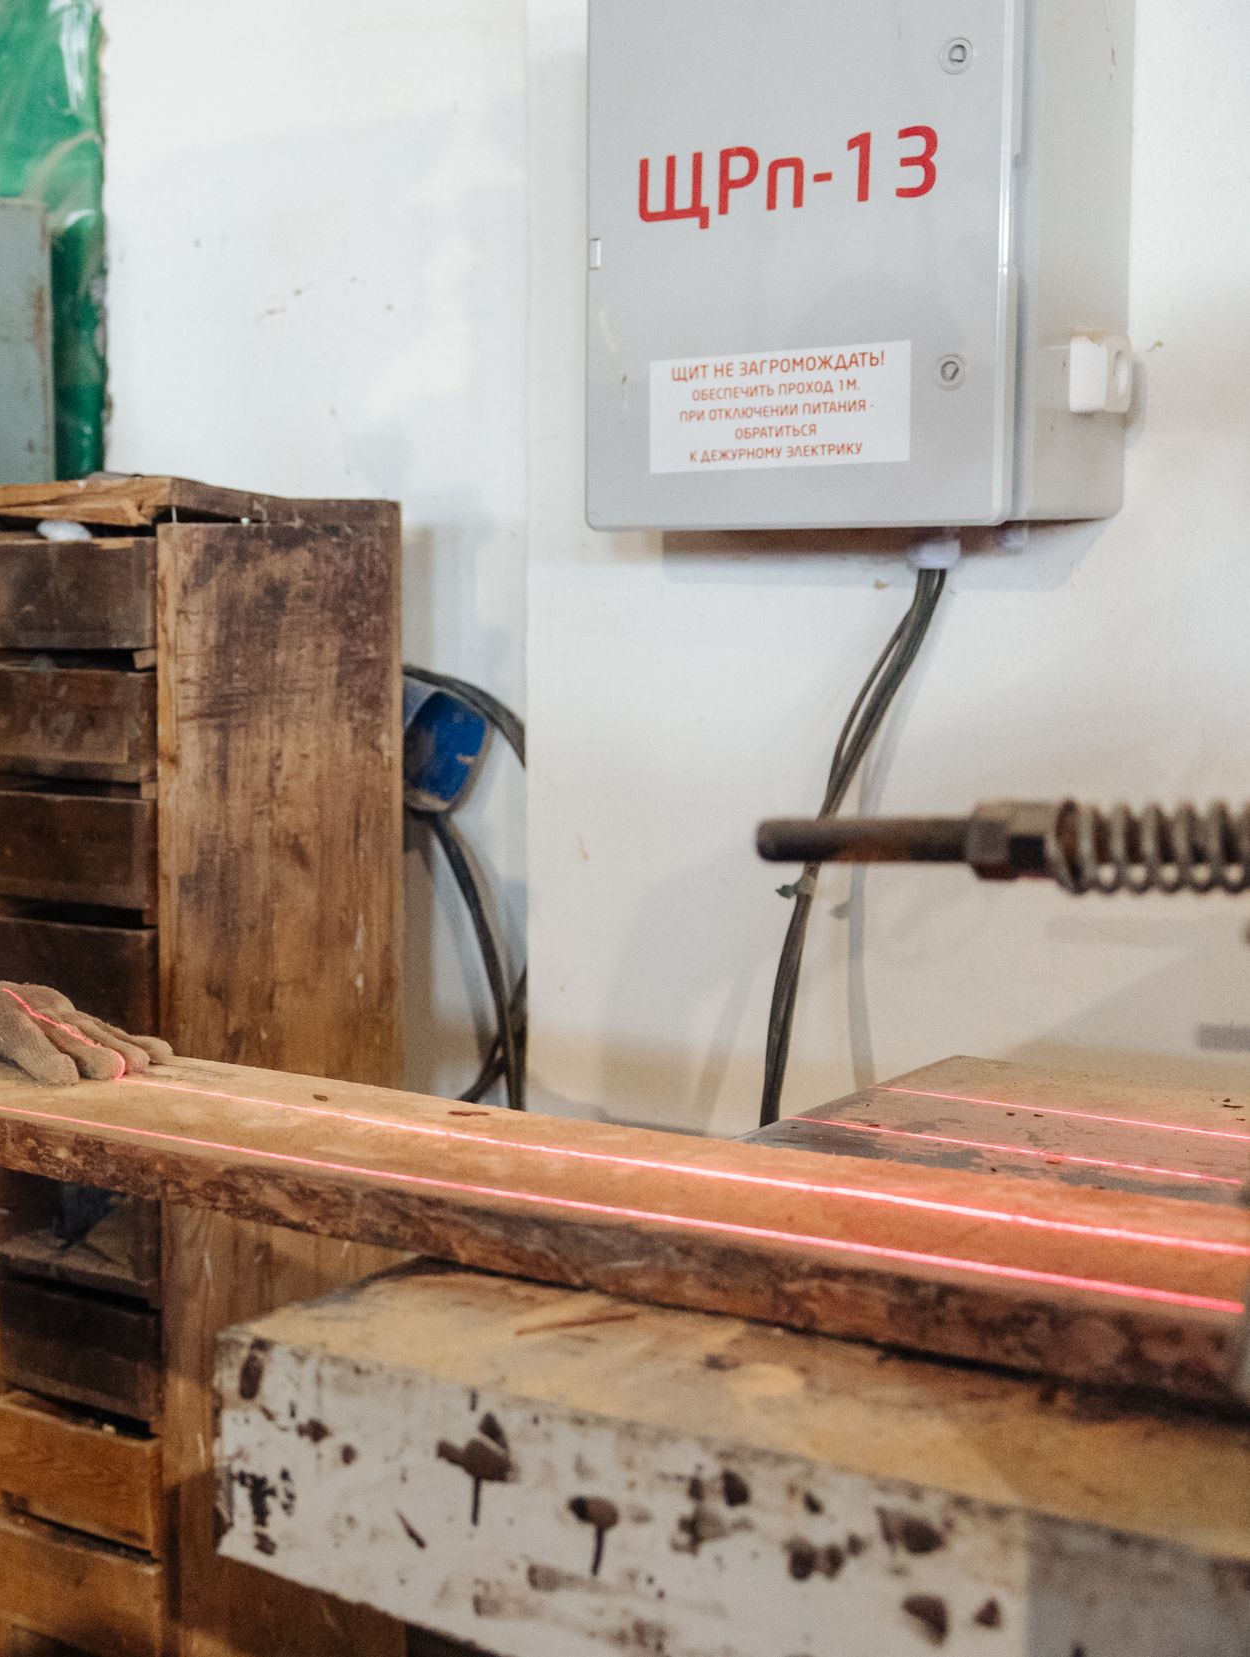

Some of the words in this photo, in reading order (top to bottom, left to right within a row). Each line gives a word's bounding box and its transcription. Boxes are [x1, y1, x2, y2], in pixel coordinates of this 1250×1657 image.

[638, 125, 939, 230] ЩРп-13
[671, 363, 709, 382] ЩИТ
[713, 362, 734, 378] НЕ
[740, 351, 885, 376] ЗАГРОМОЖДАТЬ!
[692, 384, 774, 401] ОБЕСПЕЧИТЬ
[778, 379, 833, 396] ПРОХОД
[680, 409, 705, 422] ПРИ
[709, 402, 798, 420] ОТКЛЮЧЕНИИ
[802, 399, 867, 415] ПИТАНИЯ
[734, 423, 818, 440] ОБРАТИТЬСЯ
[688, 450, 697, 463] К
[700, 446, 782, 464] ДЕЖУРНОМУ
[787, 442, 863, 458] ЭЛЕКТРИКУ
